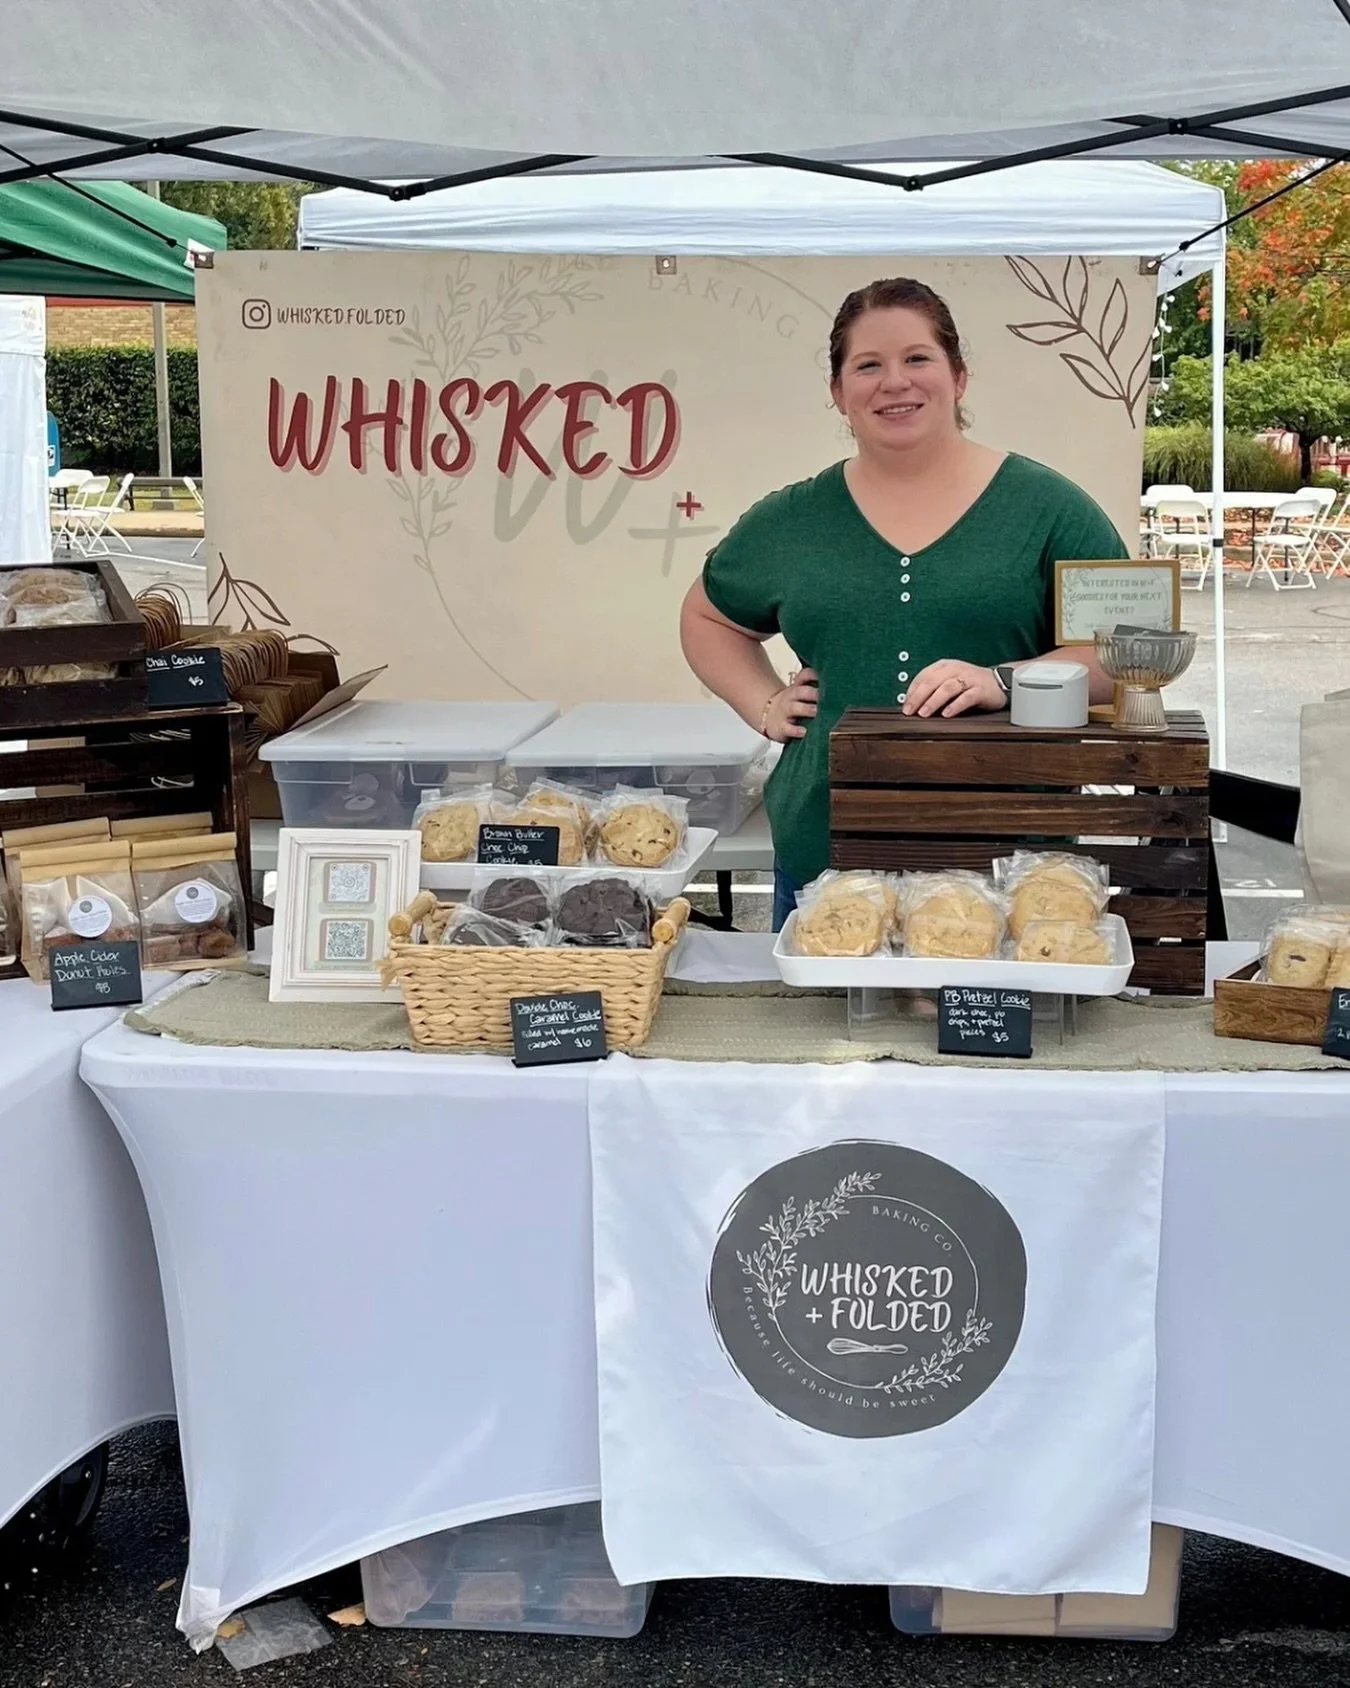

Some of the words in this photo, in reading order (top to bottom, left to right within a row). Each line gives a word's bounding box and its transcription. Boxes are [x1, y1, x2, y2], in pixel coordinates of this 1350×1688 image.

[267, 374, 682, 480] WHISKED
[145, 655, 168, 668] Chai
[170, 654, 206, 666] Cookie
[482, 827, 513, 839] Brown
[515, 828, 545, 839] Butter
[53, 951, 87, 967] Apple
[54, 965, 93, 982] Donut
[944, 989, 961, 1003] PB
[961, 989, 998, 1004] Pretzel
[1000, 991, 1031, 1006] Cookie
[529, 1011, 570, 1025] Caramel
[572, 1008, 602, 1021] Cookie
[527, 1037, 562, 1051] caramel
[872, 1205, 930, 1233] BAKING
[801, 1262, 953, 1298] WHISKED
[830, 1297, 951, 1333] FOLDED
[742, 1286, 771, 1347] Because
[771, 1350, 796, 1376] life
[800, 1377, 853, 1406] should
[862, 1397, 880, 1409] be
[889, 1393, 936, 1409] sweet
